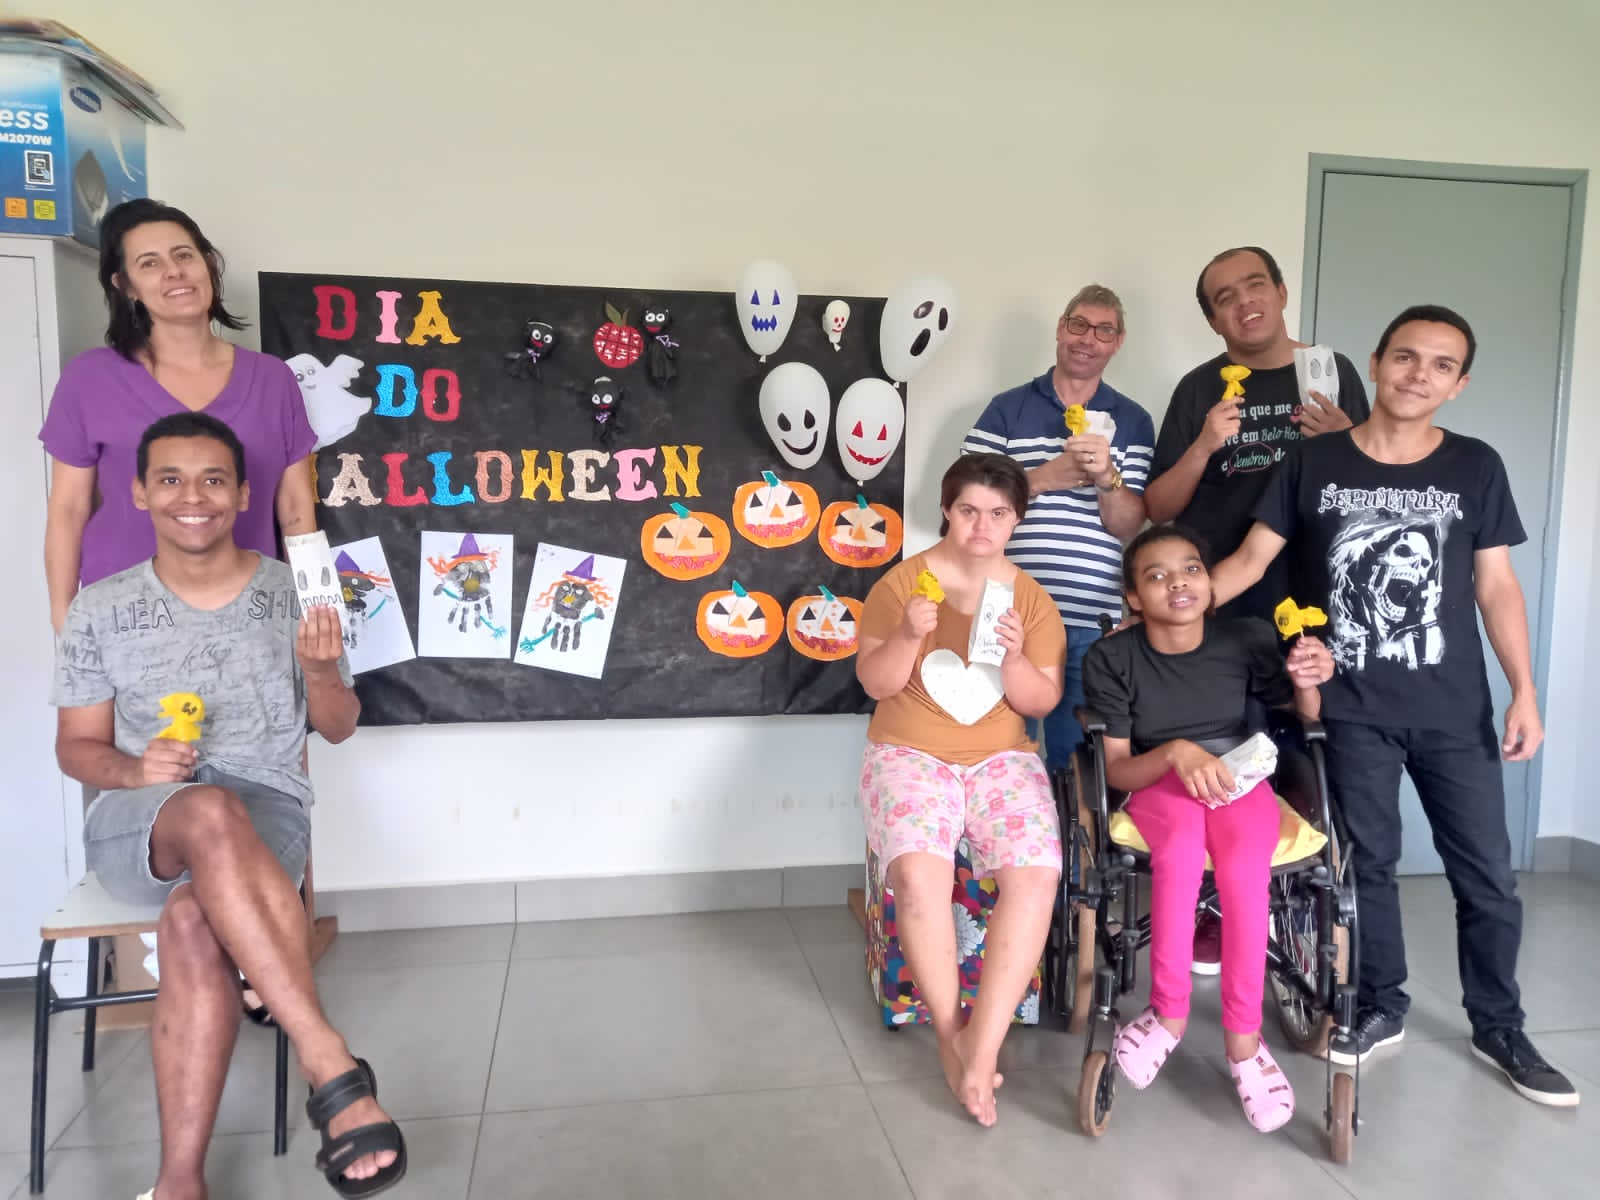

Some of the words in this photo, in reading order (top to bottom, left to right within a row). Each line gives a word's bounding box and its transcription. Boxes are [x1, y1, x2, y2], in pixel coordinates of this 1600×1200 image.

[313, 285, 461, 345] DIA
[373, 364, 462, 422] DO
[1249, 404, 1271, 421] que
[1274, 403, 1292, 415] me
[1241, 431, 1259, 443] em
[309, 445, 703, 507] ALLOWEEN
[1318, 483, 1463, 519] SEPULTURA
